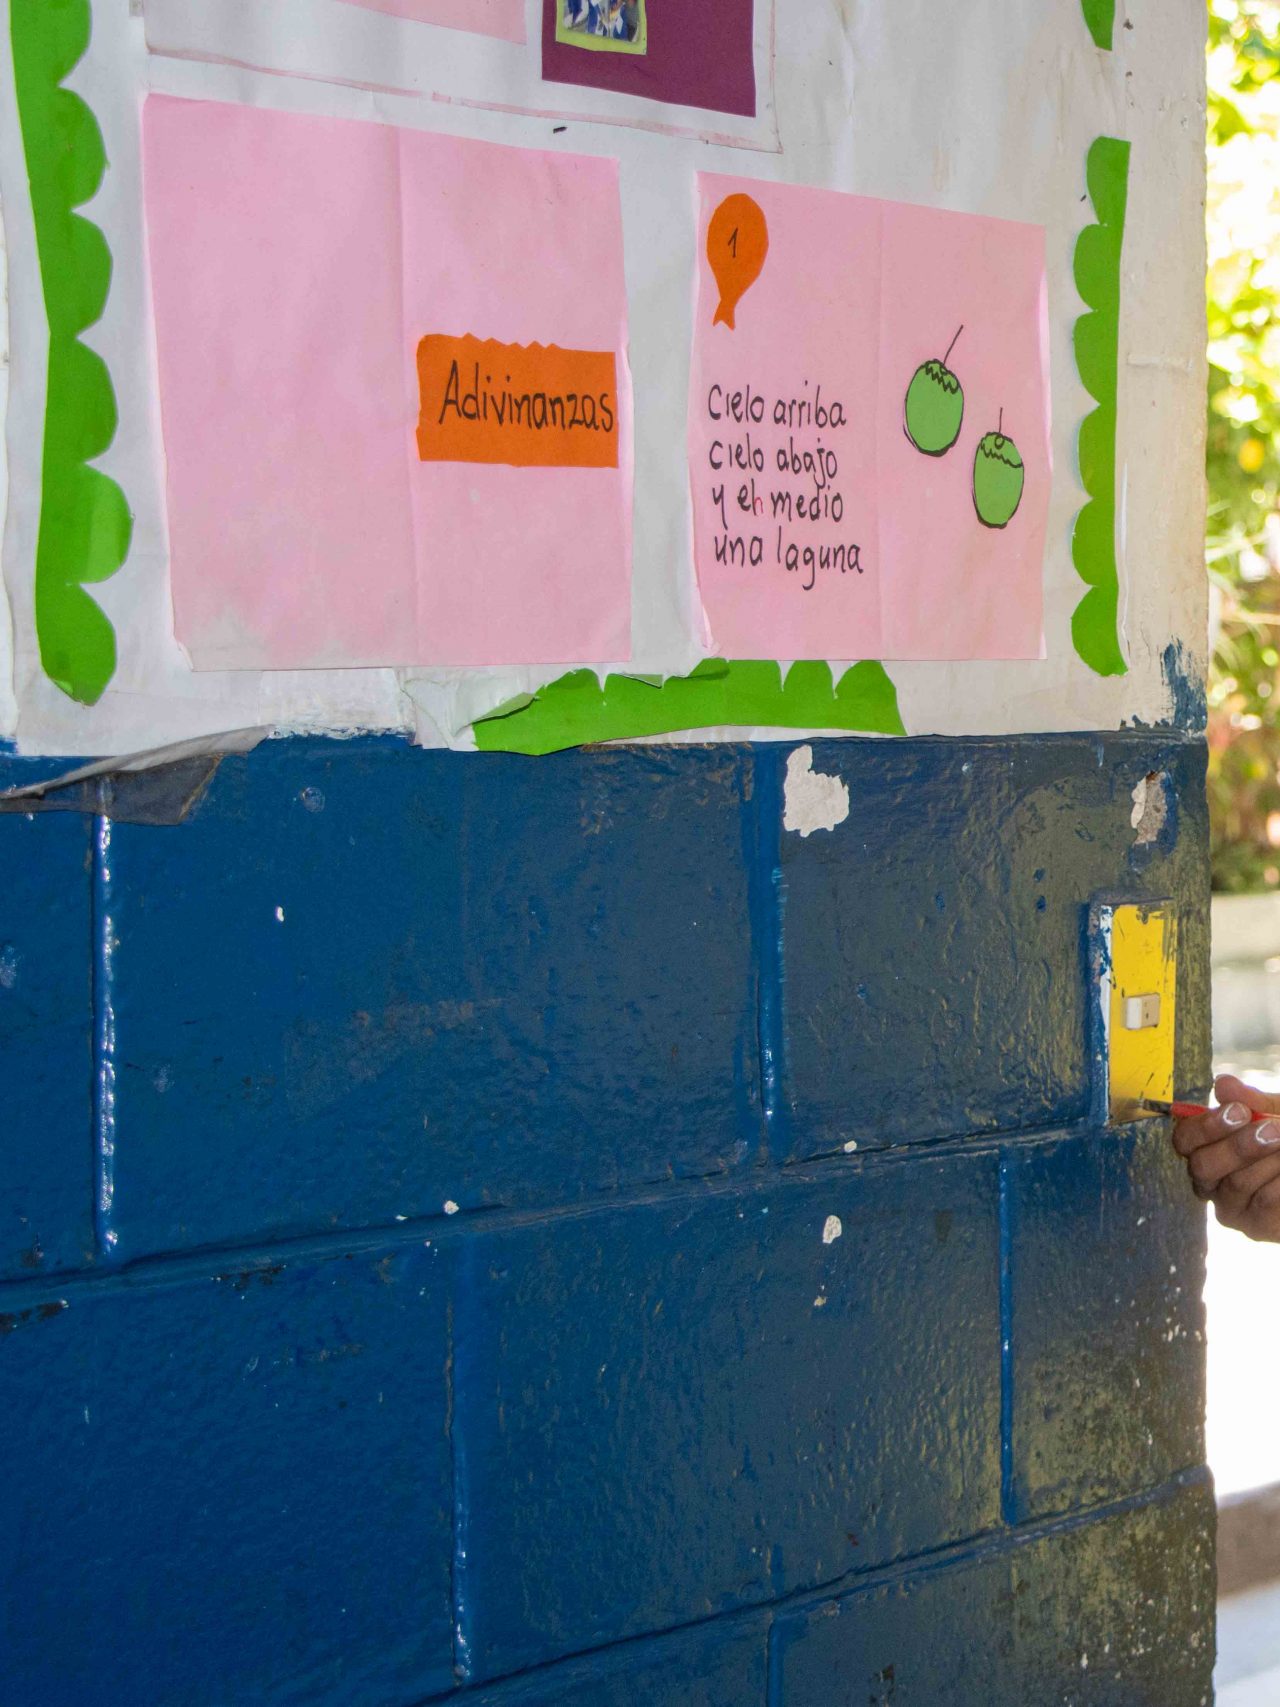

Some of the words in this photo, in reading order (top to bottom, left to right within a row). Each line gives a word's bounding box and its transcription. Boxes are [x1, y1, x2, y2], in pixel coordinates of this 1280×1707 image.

[727, 227, 739, 258] 1
[438, 359, 614, 433] Adivinanzas
[773, 380, 847, 429] arriba
[709, 432, 764, 472] cielo
[777, 436, 838, 490] abajo
[712, 484, 728, 531] y
[770, 484, 844, 523] medio
[714, 534, 763, 568] una
[777, 526, 864, 591] laguna
